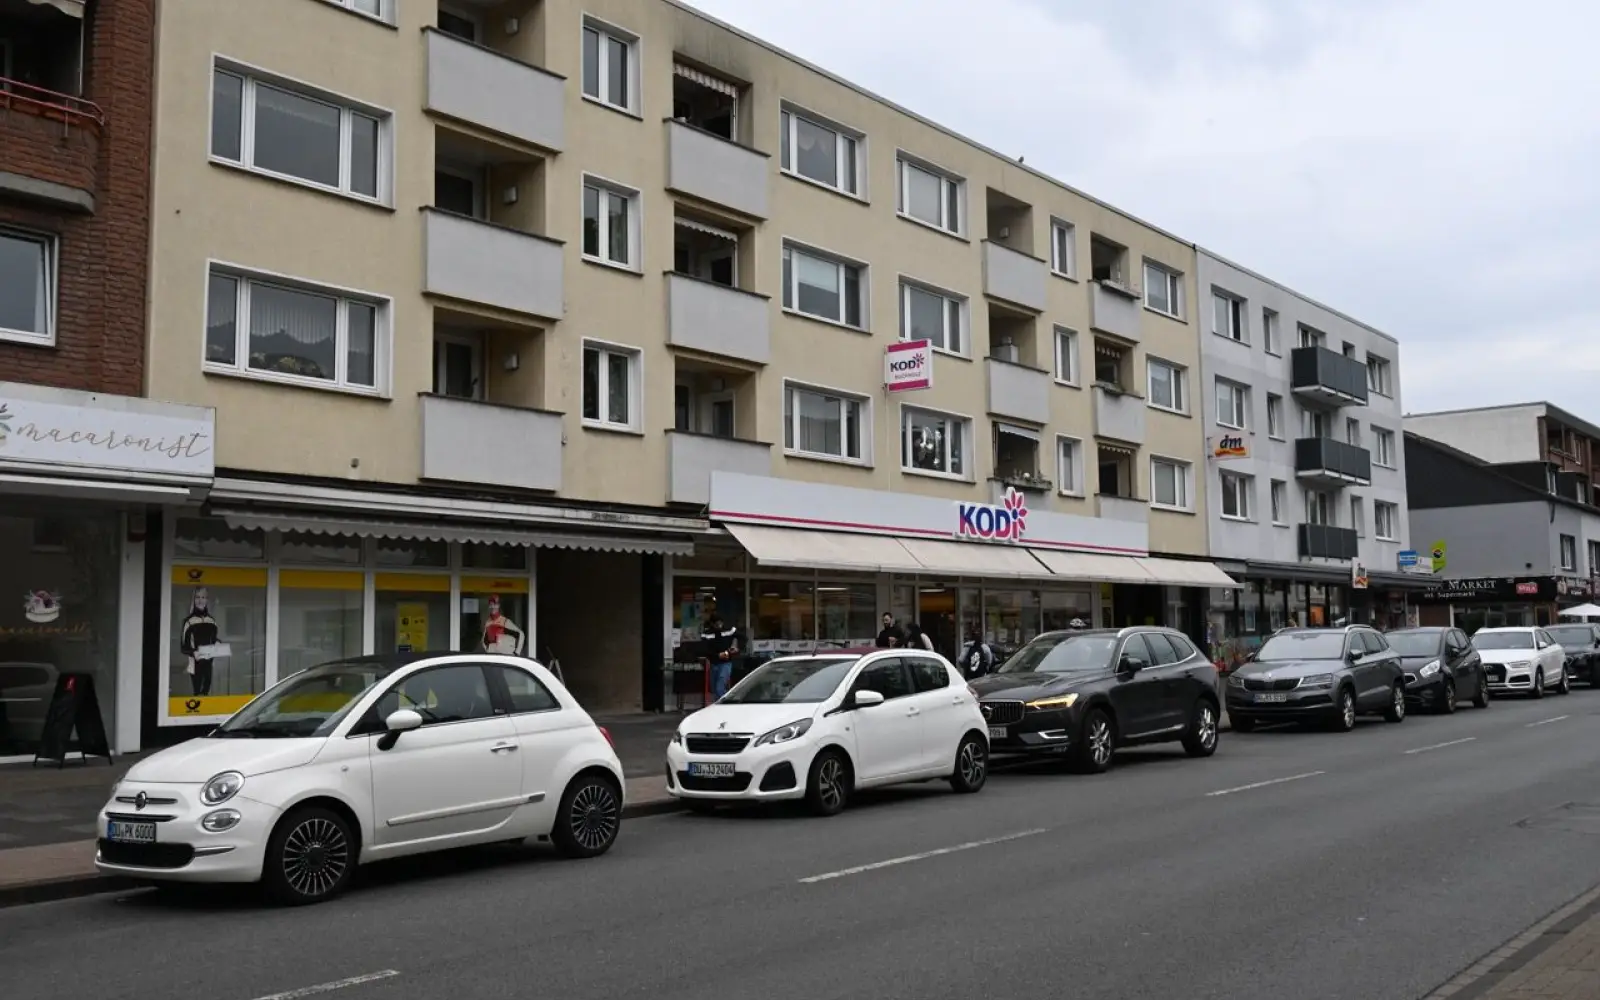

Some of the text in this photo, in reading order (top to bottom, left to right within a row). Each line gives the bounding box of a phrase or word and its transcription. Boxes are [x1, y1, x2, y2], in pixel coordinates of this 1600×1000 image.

[16, 423, 211, 459] macaronist
[1220, 434, 1242, 448] dm
[1449, 579, 1498, 592] MARKET
[124, 823, 135, 838] PK
[135, 824, 154, 839] 6000
